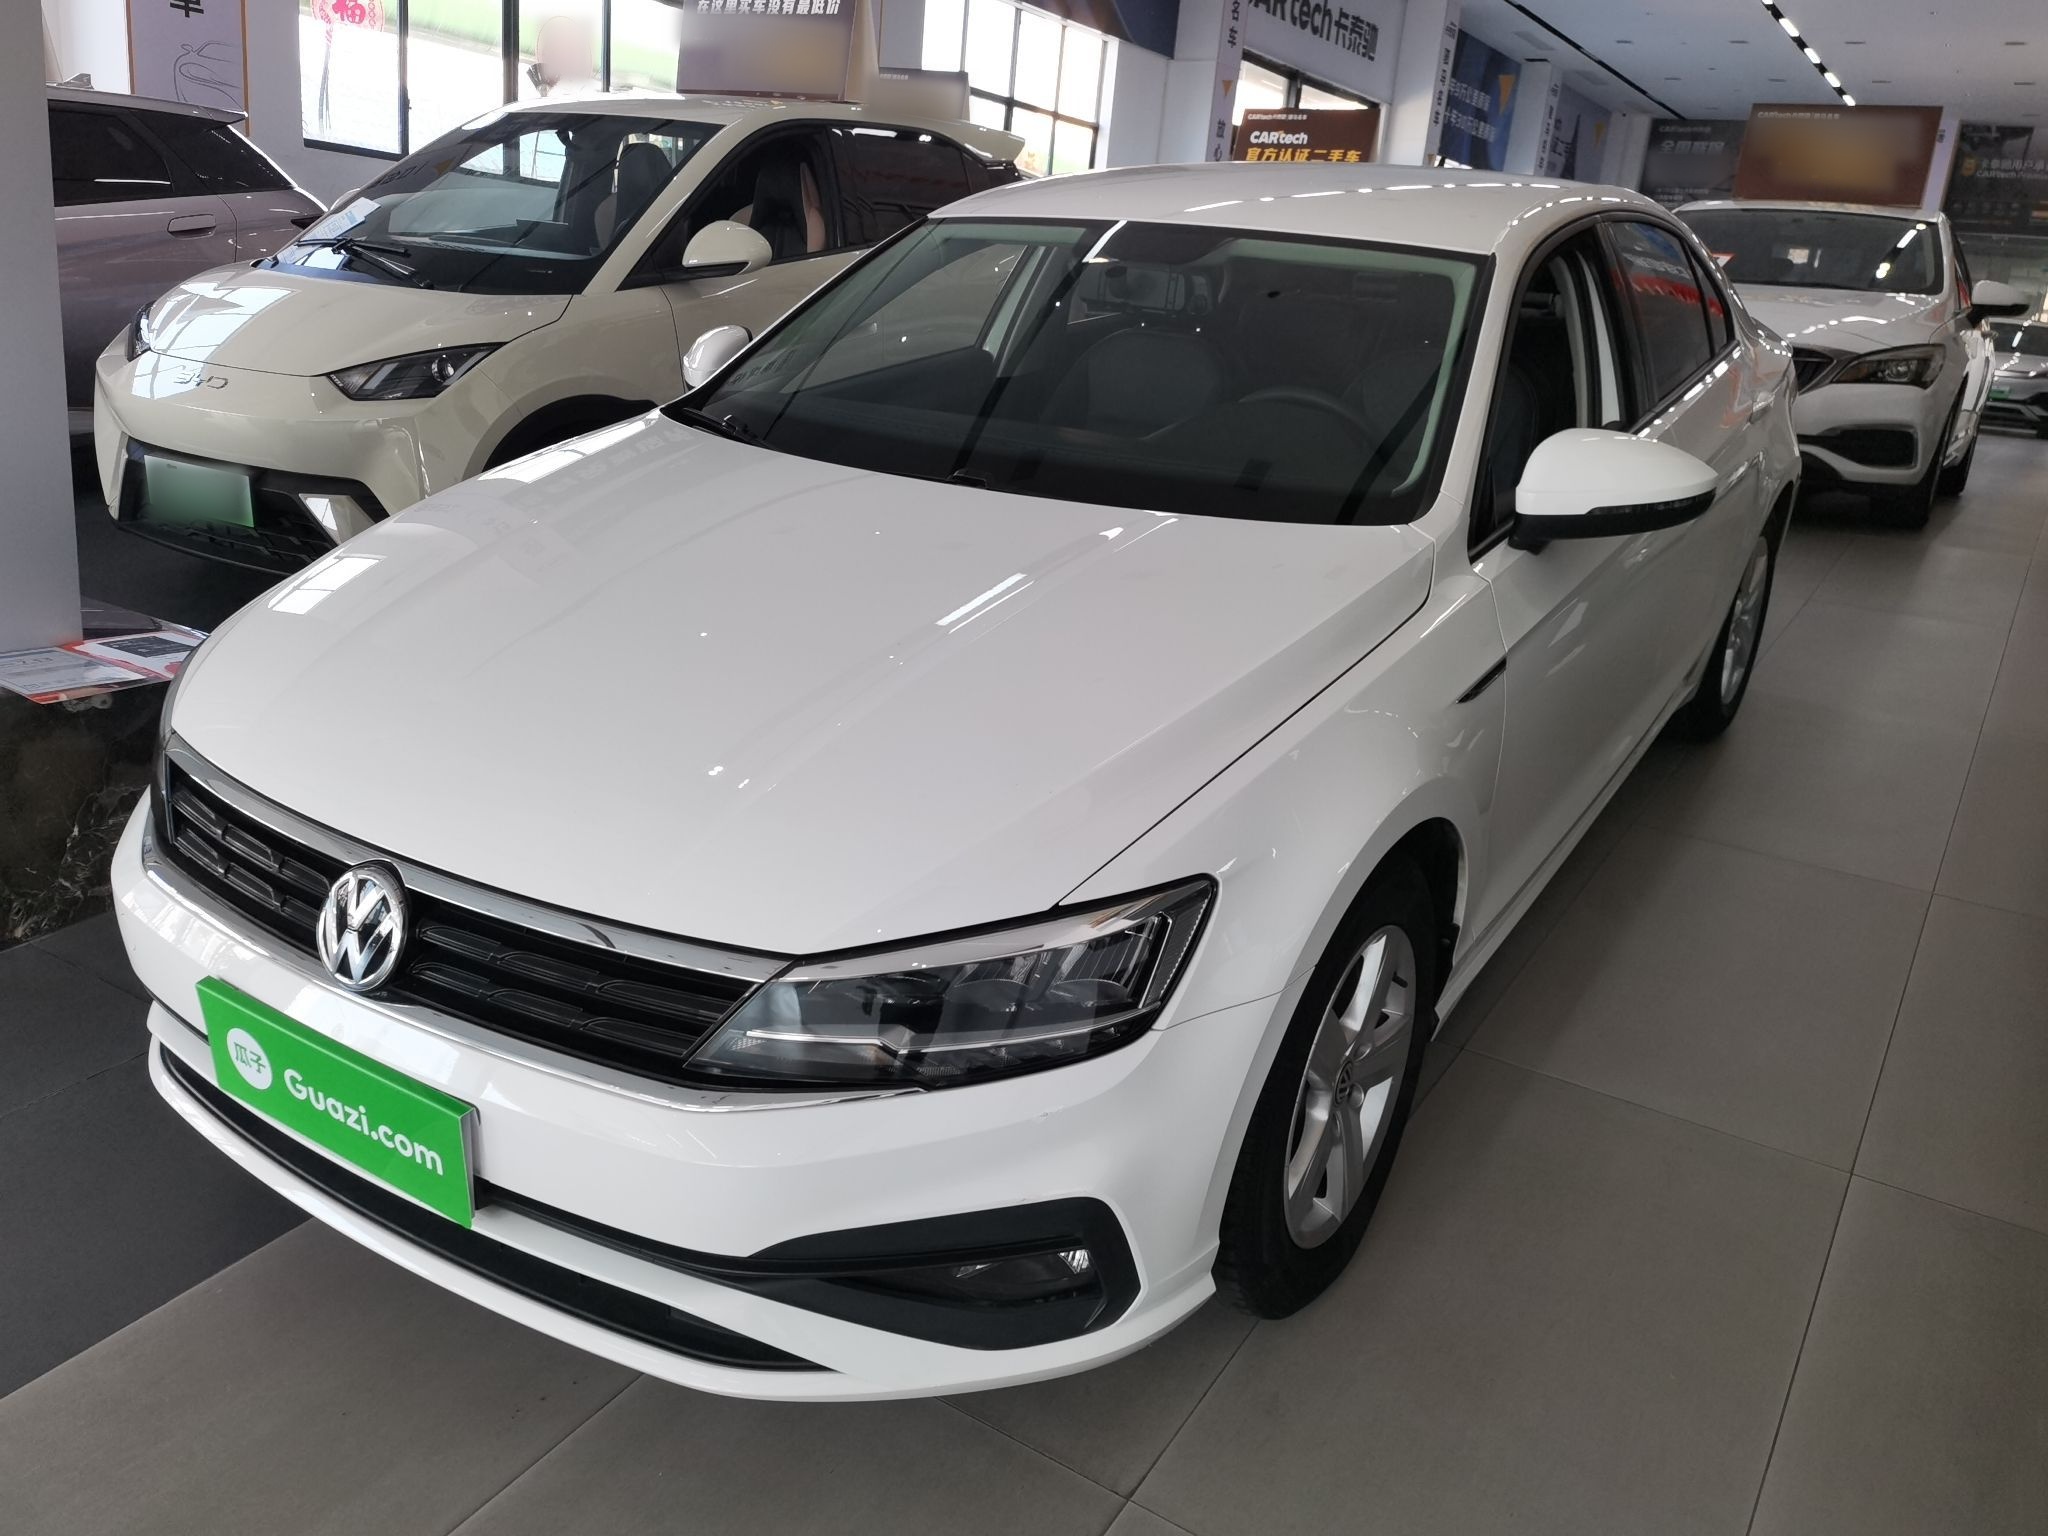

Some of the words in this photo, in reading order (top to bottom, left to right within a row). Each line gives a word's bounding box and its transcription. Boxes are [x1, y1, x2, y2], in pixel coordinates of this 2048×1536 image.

[697, 0, 841, 15] 在这里买车没有最低价
[1250, 131, 1309, 145] CARtech
[1245, 147, 1361, 162] 官方认证二手车
[233, 1041, 266, 1075] 瓜子
[284, 1068, 444, 1176] Guazi.com
